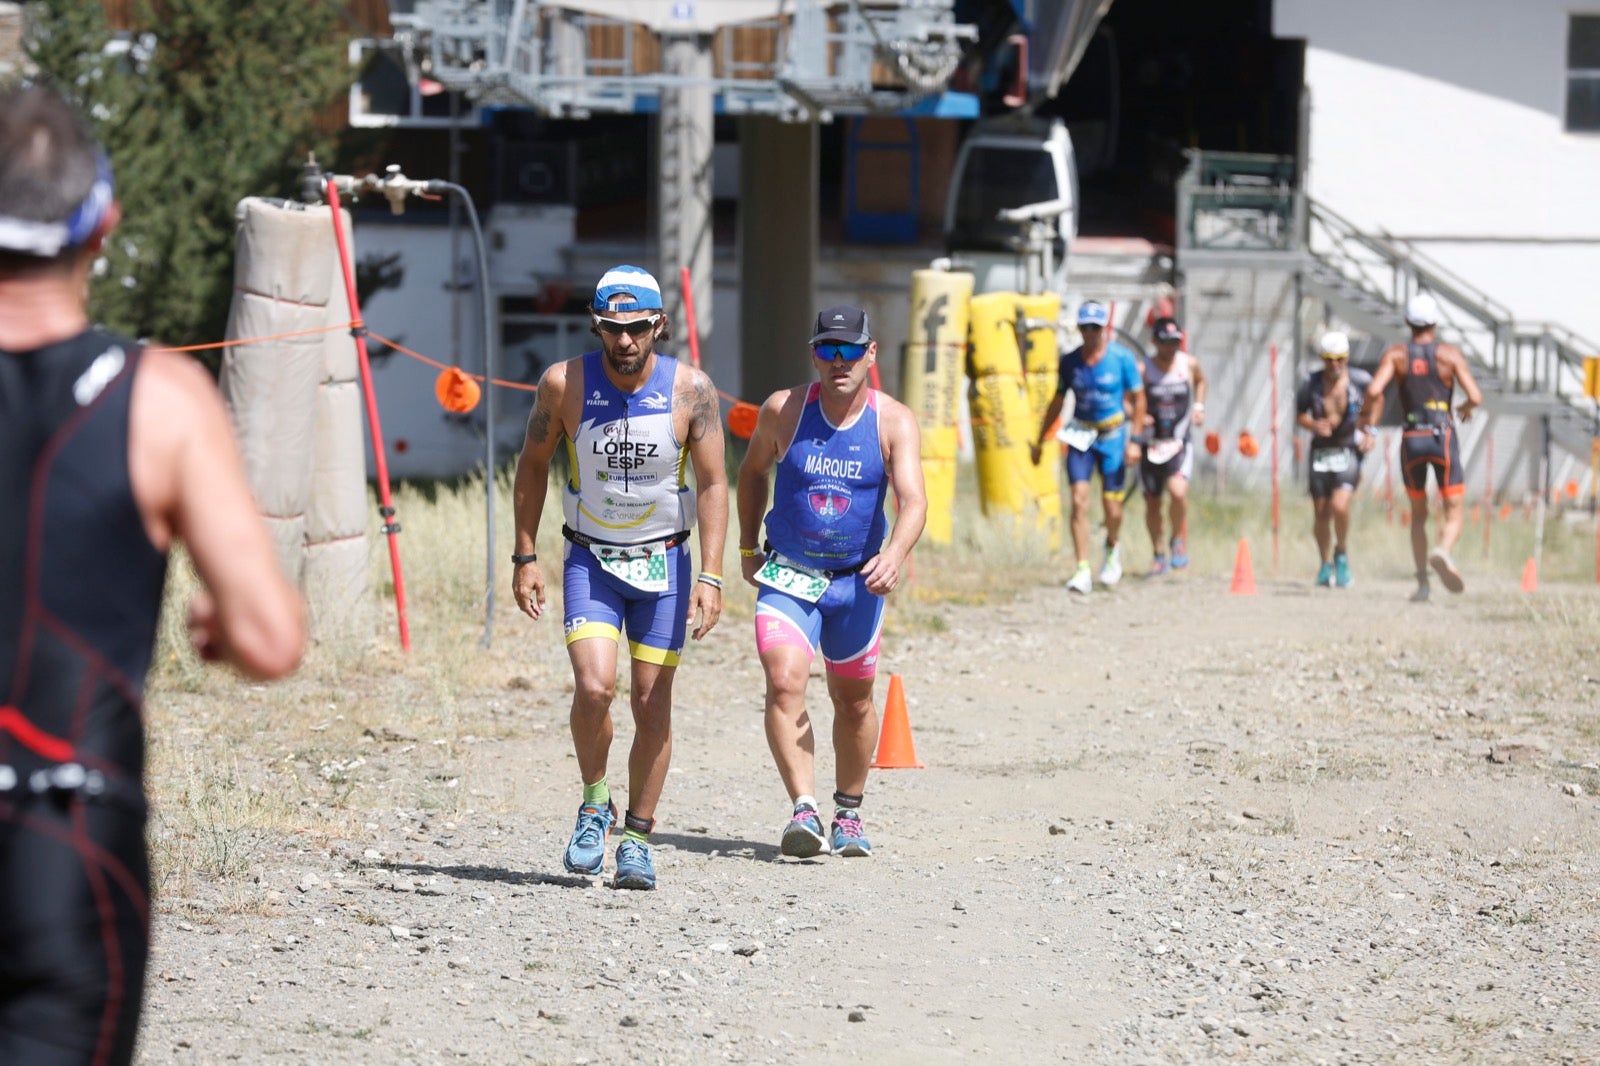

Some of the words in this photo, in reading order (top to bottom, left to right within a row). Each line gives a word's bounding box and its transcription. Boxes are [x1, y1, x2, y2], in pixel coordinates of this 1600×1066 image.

[592, 438, 659, 457] LÓPEZ
[607, 457, 645, 470] ESP
[804, 451, 862, 479] MÁRQUEZ
[610, 558, 650, 581] 98
